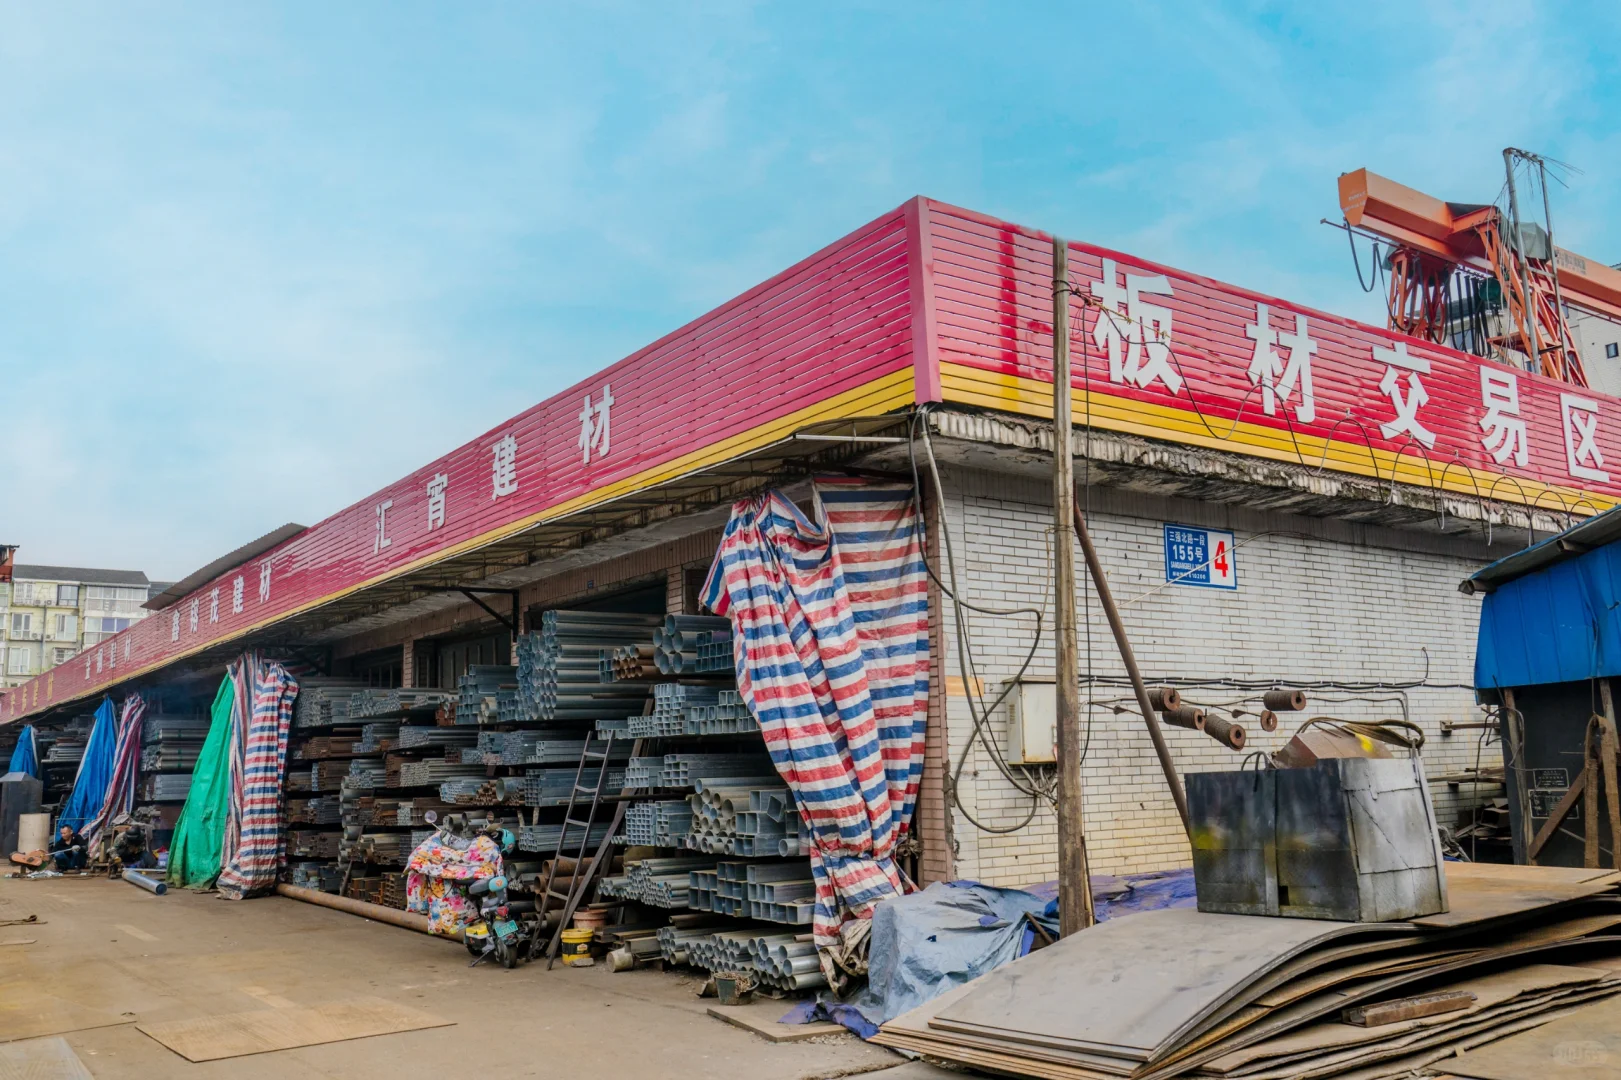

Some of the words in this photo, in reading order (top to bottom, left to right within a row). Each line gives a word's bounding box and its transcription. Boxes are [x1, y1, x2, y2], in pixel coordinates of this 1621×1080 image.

[1089, 257, 1611, 484] 板材交易区
[1172, 544, 1204, 562] 155号
[1214, 540, 1229, 578] 4
